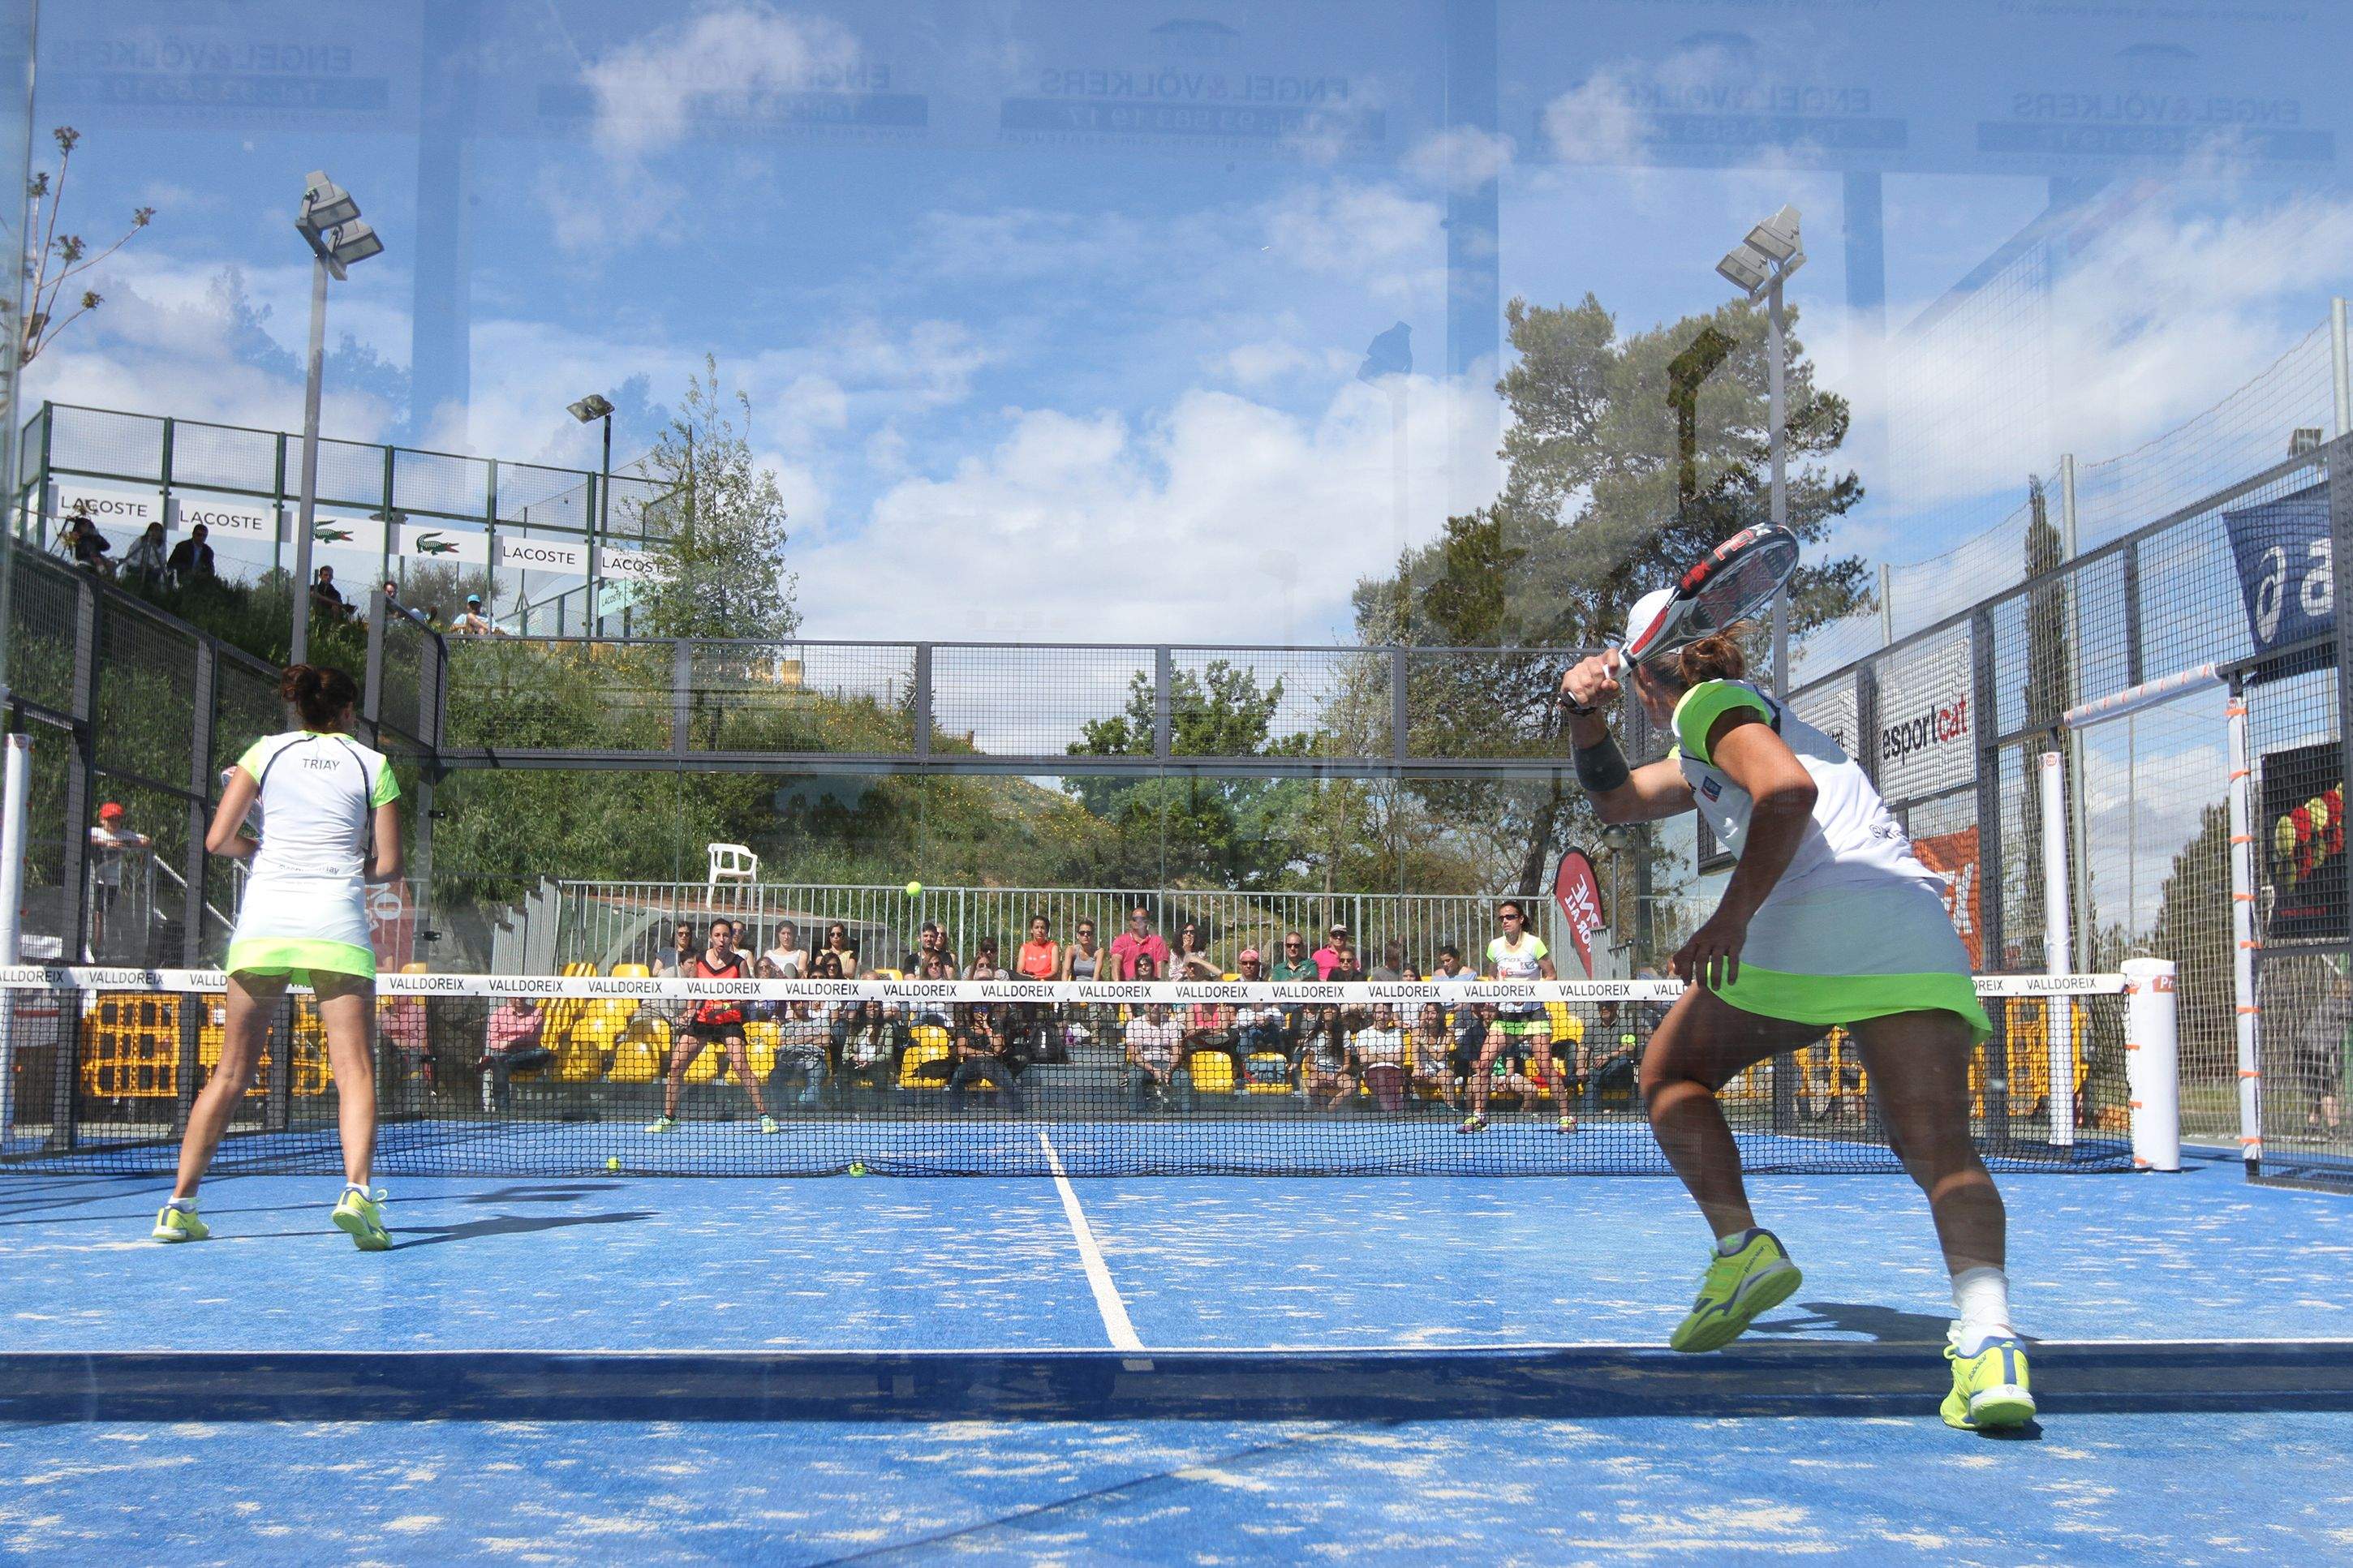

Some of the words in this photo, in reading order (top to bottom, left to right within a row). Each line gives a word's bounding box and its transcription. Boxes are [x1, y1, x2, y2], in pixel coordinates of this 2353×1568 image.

[61, 496, 148, 518] LACOSTE
[179, 509, 263, 531] LACOSTE
[502, 545, 576, 565] LACOSTE
[1882, 694, 1968, 766] esportcat
[303, 758, 341, 771] TRIAY
[0, 969, 64, 984] LLDOREIX
[88, 970, 164, 985] VALLDOREIX
[190, 973, 228, 986] VALLD
[389, 977, 465, 991] VALLDOREIX
[488, 979, 564, 993] VALLDOREIX
[587, 981, 663, 994] VALLDOREIX
[686, 982, 761, 994] VALLDOREIX
[785, 982, 860, 996] VALLDOREIX
[883, 984, 957, 997] VALLDOREIX
[980, 985, 1055, 998] VALLDOREIX
[1078, 985, 1152, 998] VALLDOREIX
[1175, 986, 1249, 999] VALLDOREIX
[1271, 986, 1345, 999] VALLDOREIX
[1368, 985, 1441, 998] VALLDOREIX
[1464, 985, 1536, 998] VALLDOREIX
[1558, 983, 1631, 997] VALLDOREIX
[2026, 977, 2097, 990] VALLDOREIX
